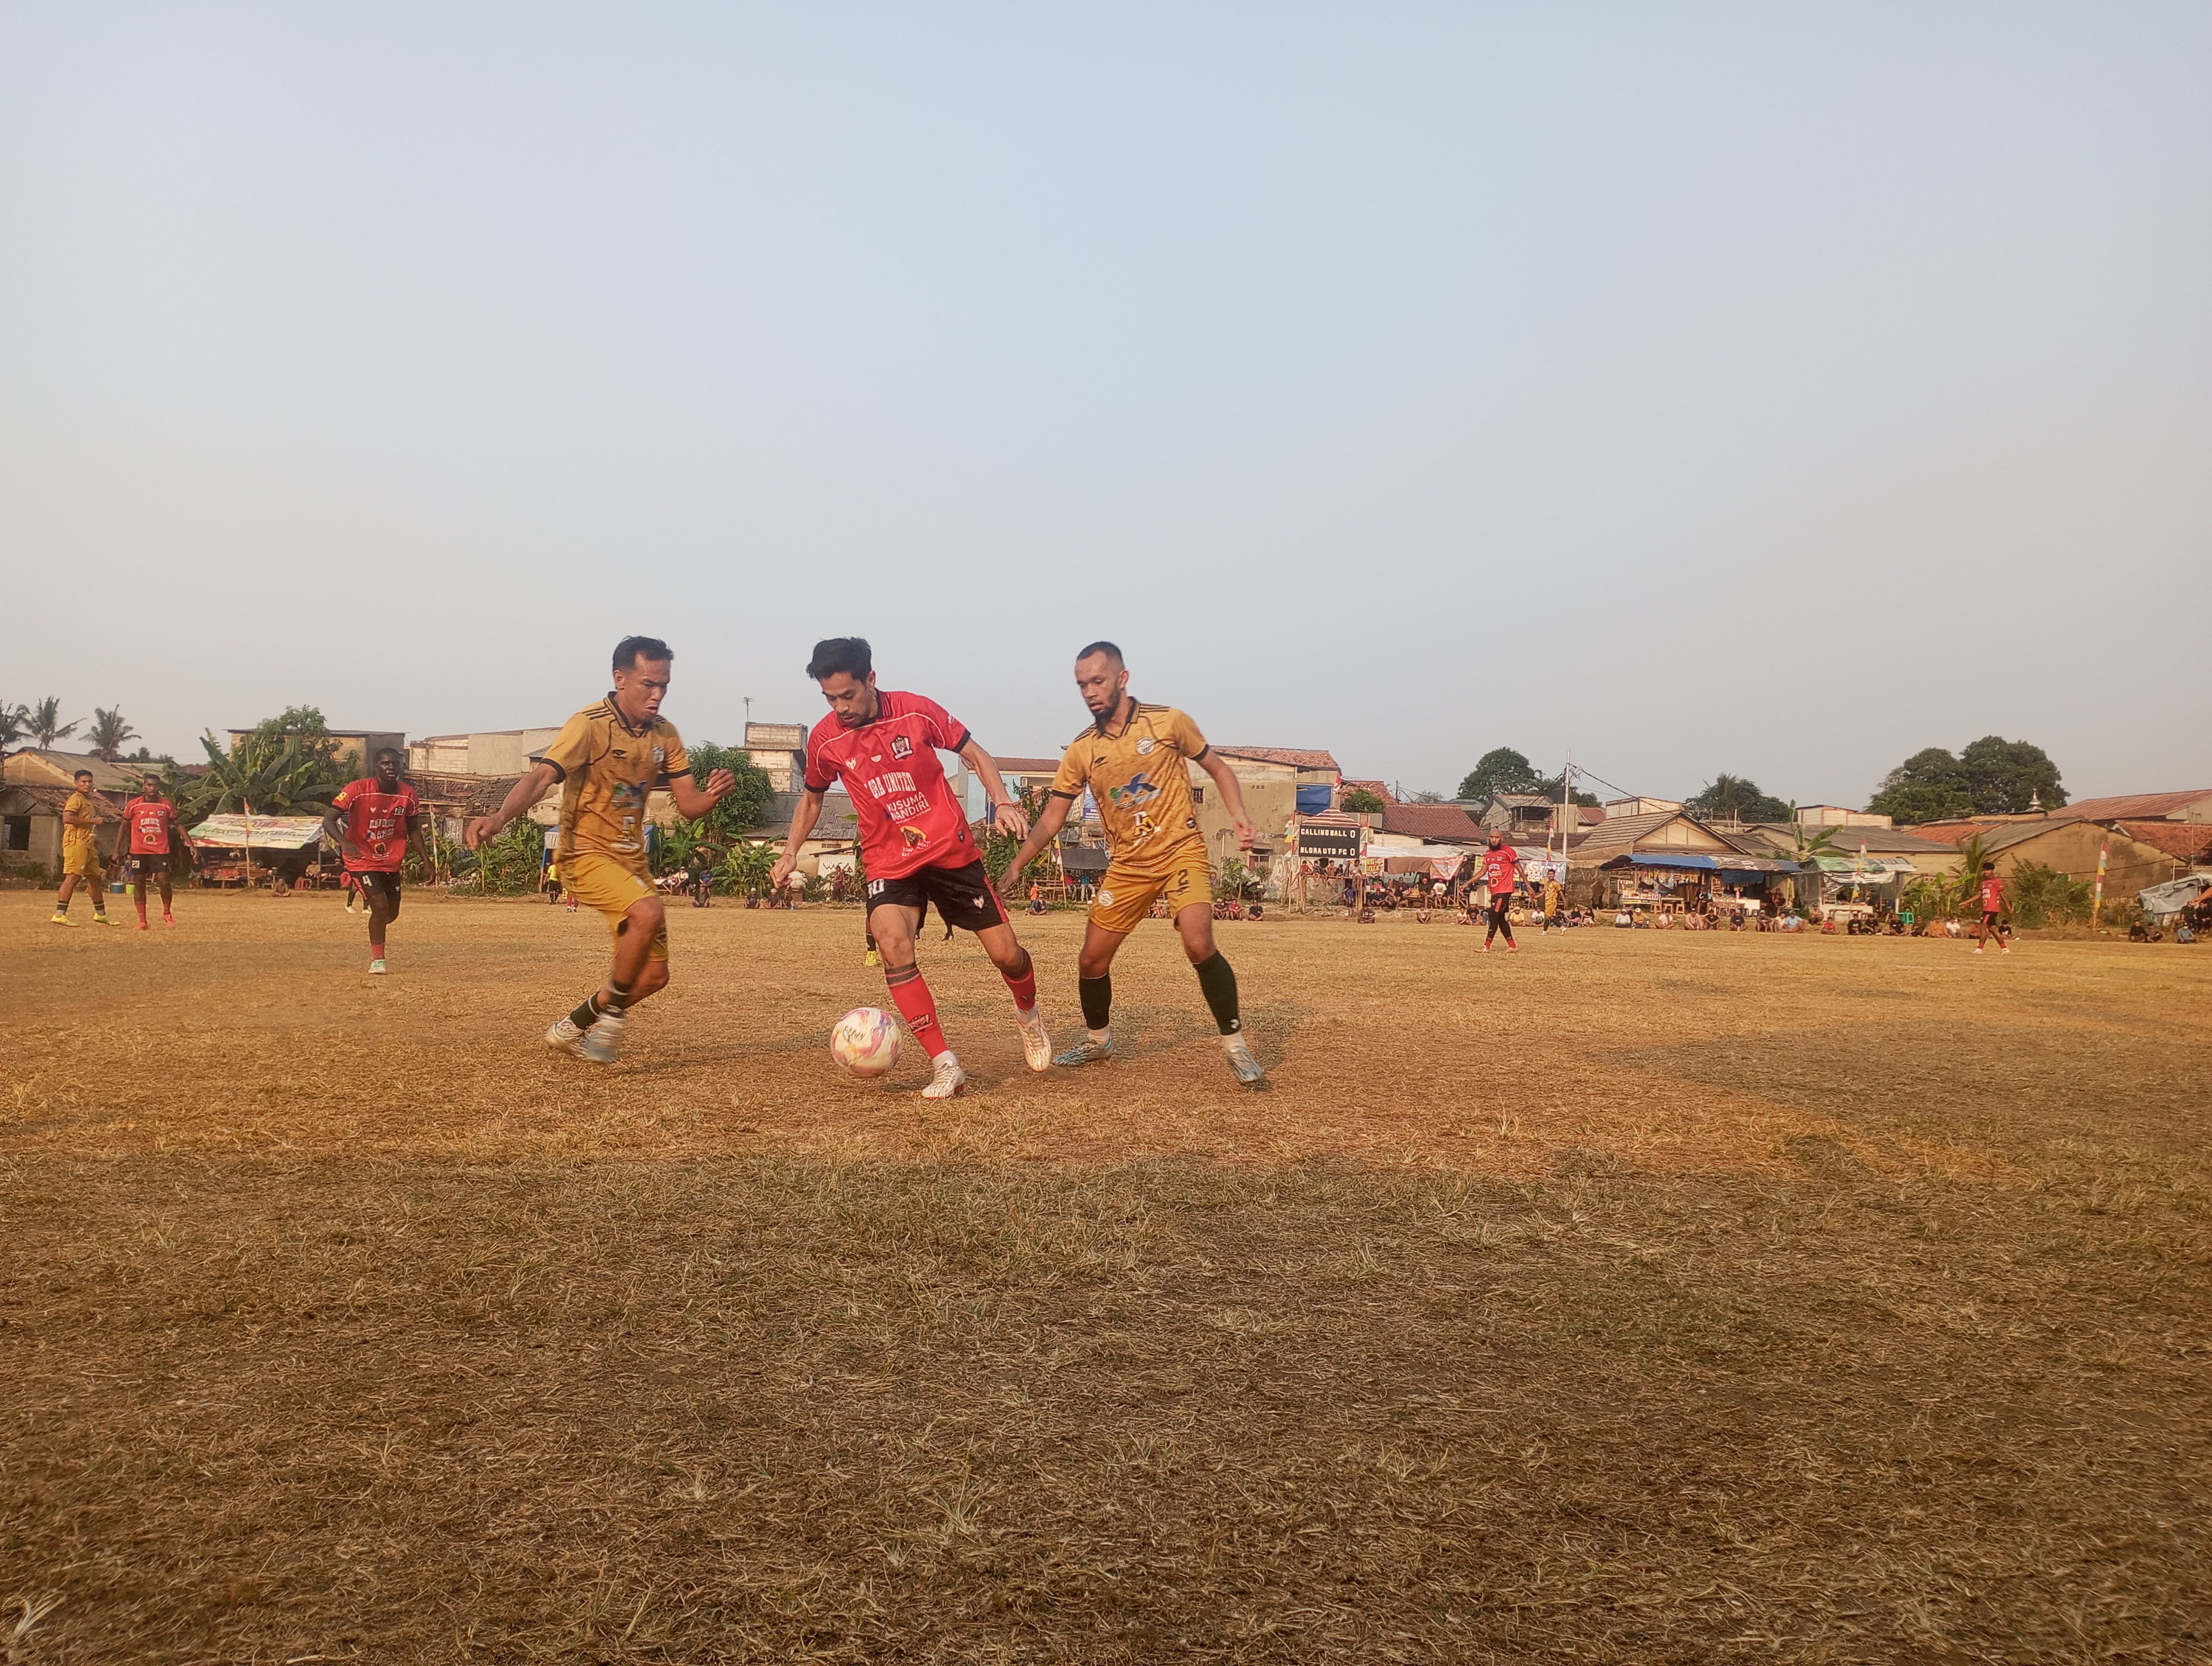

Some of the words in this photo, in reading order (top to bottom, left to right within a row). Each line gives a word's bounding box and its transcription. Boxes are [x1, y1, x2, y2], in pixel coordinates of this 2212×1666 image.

[882, 772, 917, 793] UNITED
[1350, 830, 1355, 838] 0
[1300, 847, 1322, 855] BLORA
[1350, 848, 1355, 856] 0
[362, 875, 372, 887] 4
[1178, 869, 1189, 887] 2
[867, 878, 885, 899] 10
